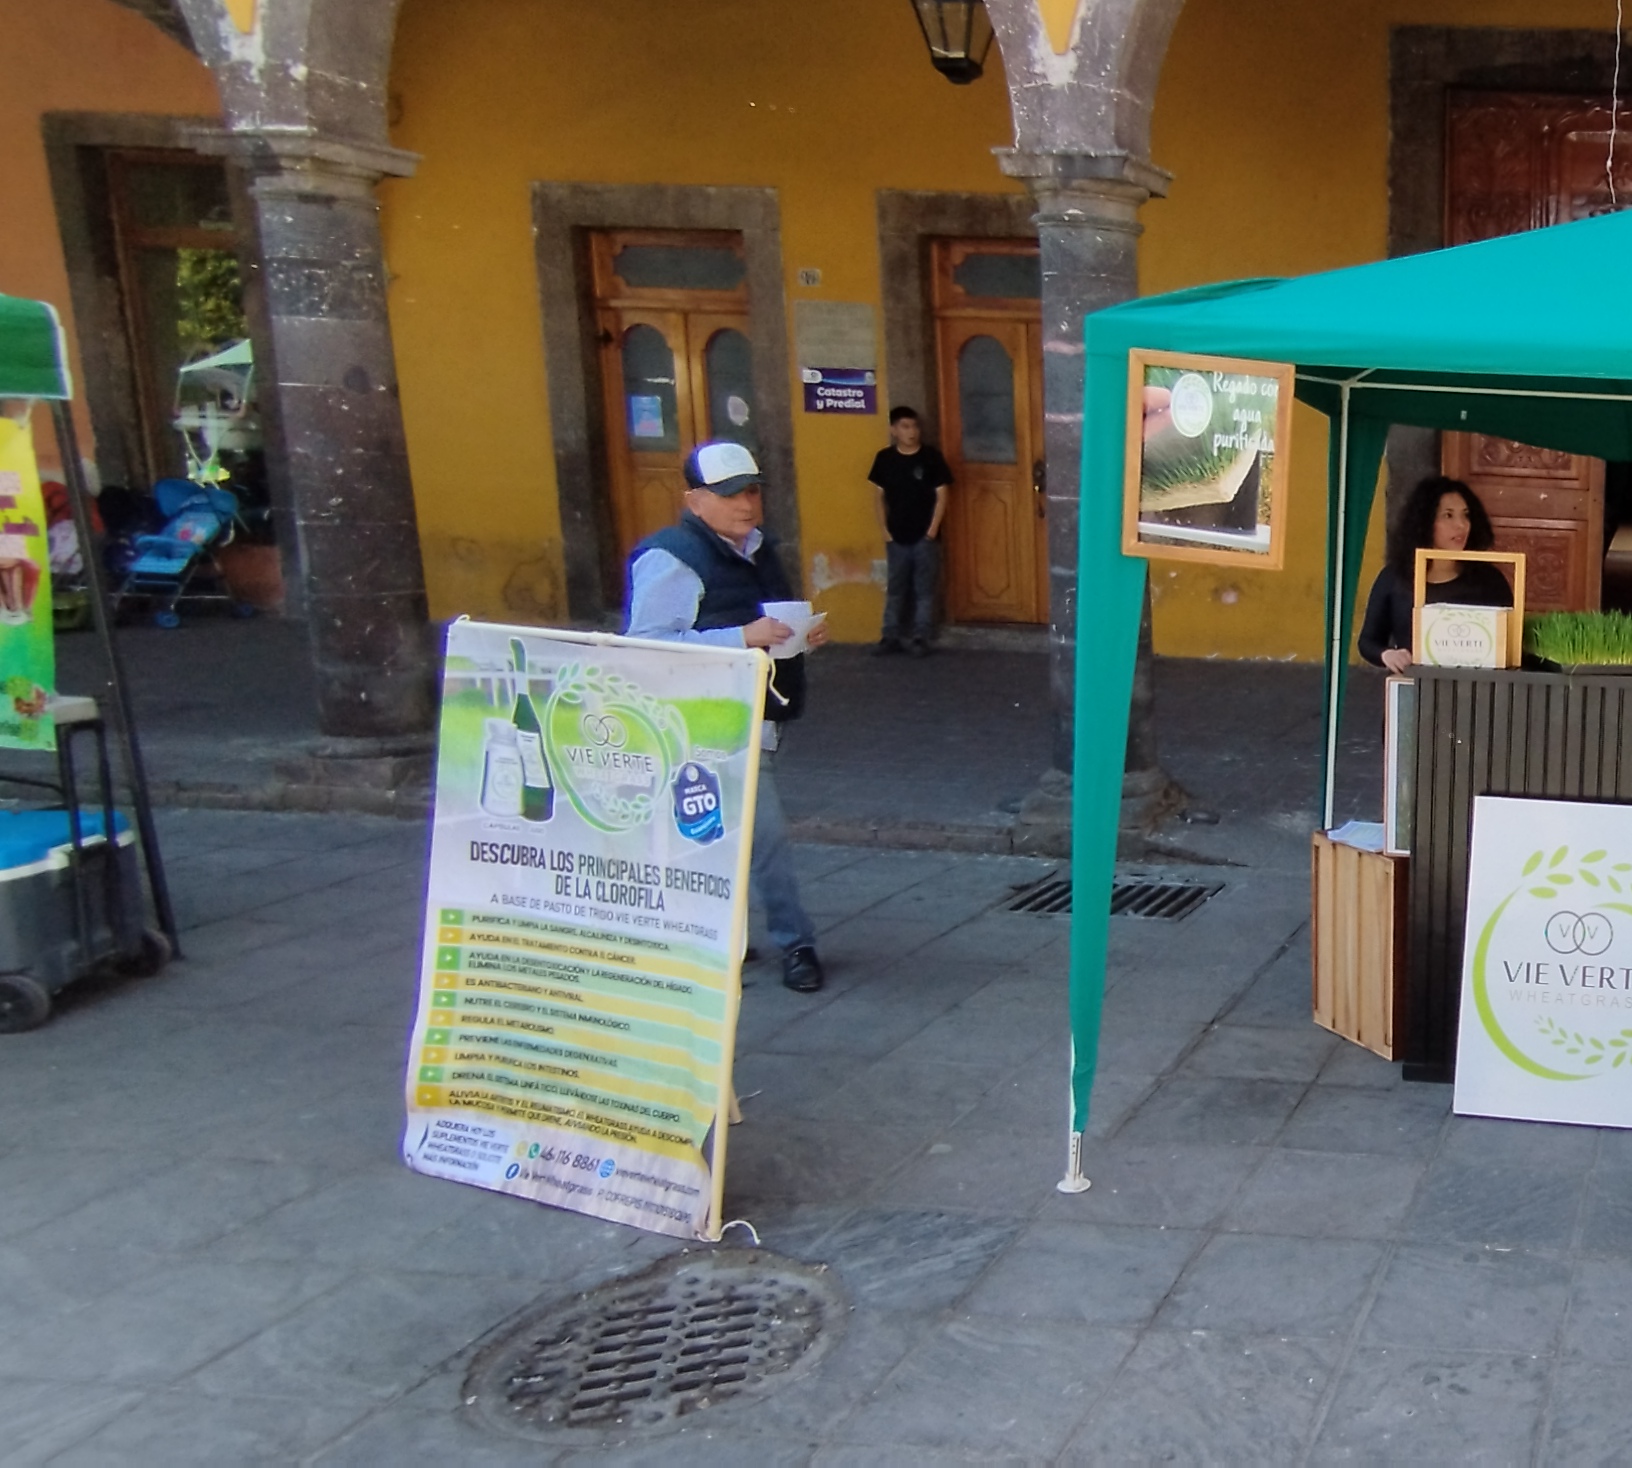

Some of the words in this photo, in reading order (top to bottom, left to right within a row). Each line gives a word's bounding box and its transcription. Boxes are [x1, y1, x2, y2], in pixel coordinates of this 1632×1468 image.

[817, 386, 864, 398] Catastro
[1213, 372, 1257, 403] Regado
[816, 400, 824, 410] y
[826, 399, 866, 409] Predial
[1233, 408, 1261, 432] agua
[567, 747, 595, 765] VIE
[601, 750, 654, 772] VERTE
[683, 792, 716, 815] GTO
[470, 840, 545, 871] DESCUBRA
[550, 852, 575, 873] LOS
[578, 855, 661, 886] PRINCIPALES
[665, 867, 731, 900] BENEFICIOS
[555, 874, 571, 895] DE
[575, 878, 591, 898] LA
[595, 880, 665, 911] CLOROFILA
[490, 893, 499, 904] A
[501, 894, 526, 908] BASE
[529, 898, 541, 910] DE
[544, 899, 571, 914] PASTO
[574, 904, 586, 917] DE
[616, 911, 630, 924] VIE
[632, 914, 661, 929] VERTE
[1503, 960, 1549, 985] VIE
